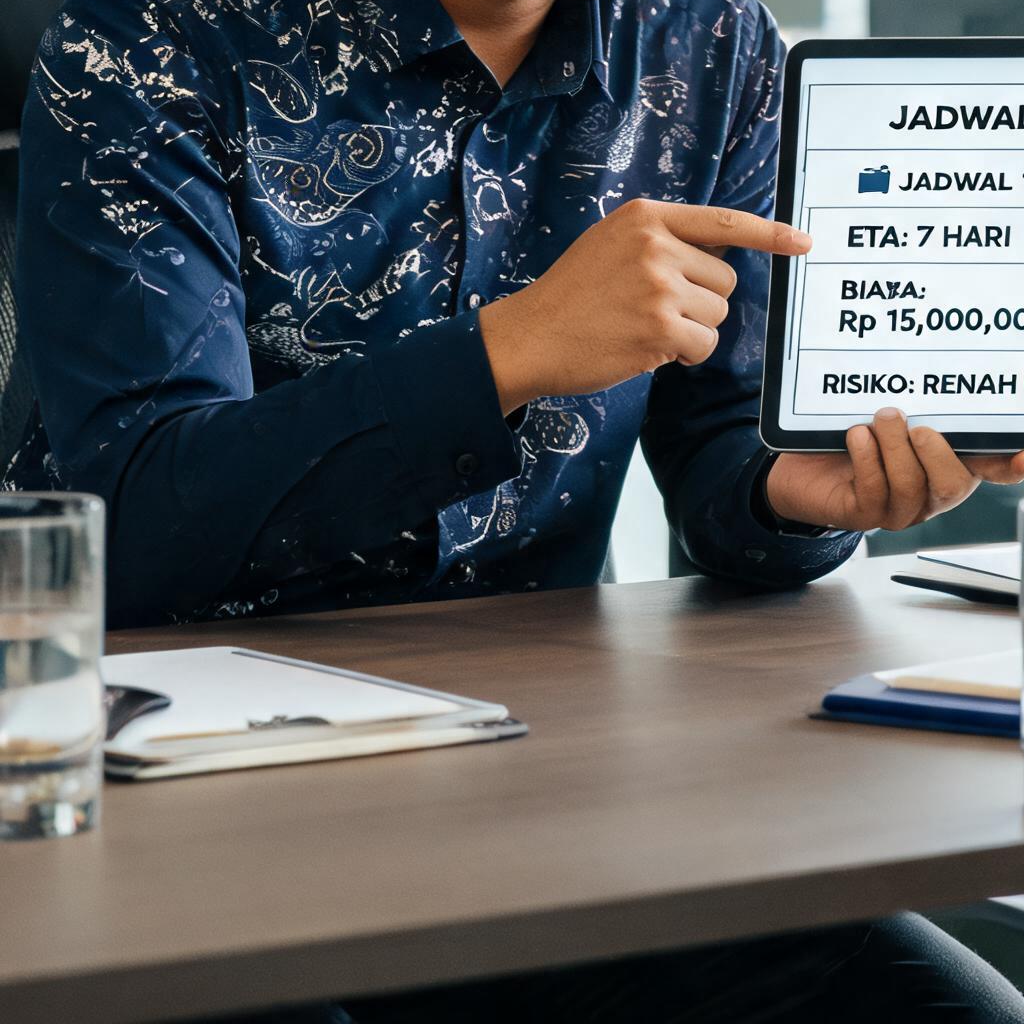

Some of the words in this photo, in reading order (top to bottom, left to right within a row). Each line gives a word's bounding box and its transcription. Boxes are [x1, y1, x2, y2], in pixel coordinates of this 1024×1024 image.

[899, 172, 1012, 191] JADWAL
[848, 226, 907, 248] ETA:
[917, 226, 934, 247] 7
[944, 225, 1010, 247] HARI
[839, 310, 876, 338] Rp
[823, 374, 914, 394] RISIKO:
[923, 374, 1017, 394] RENAH
